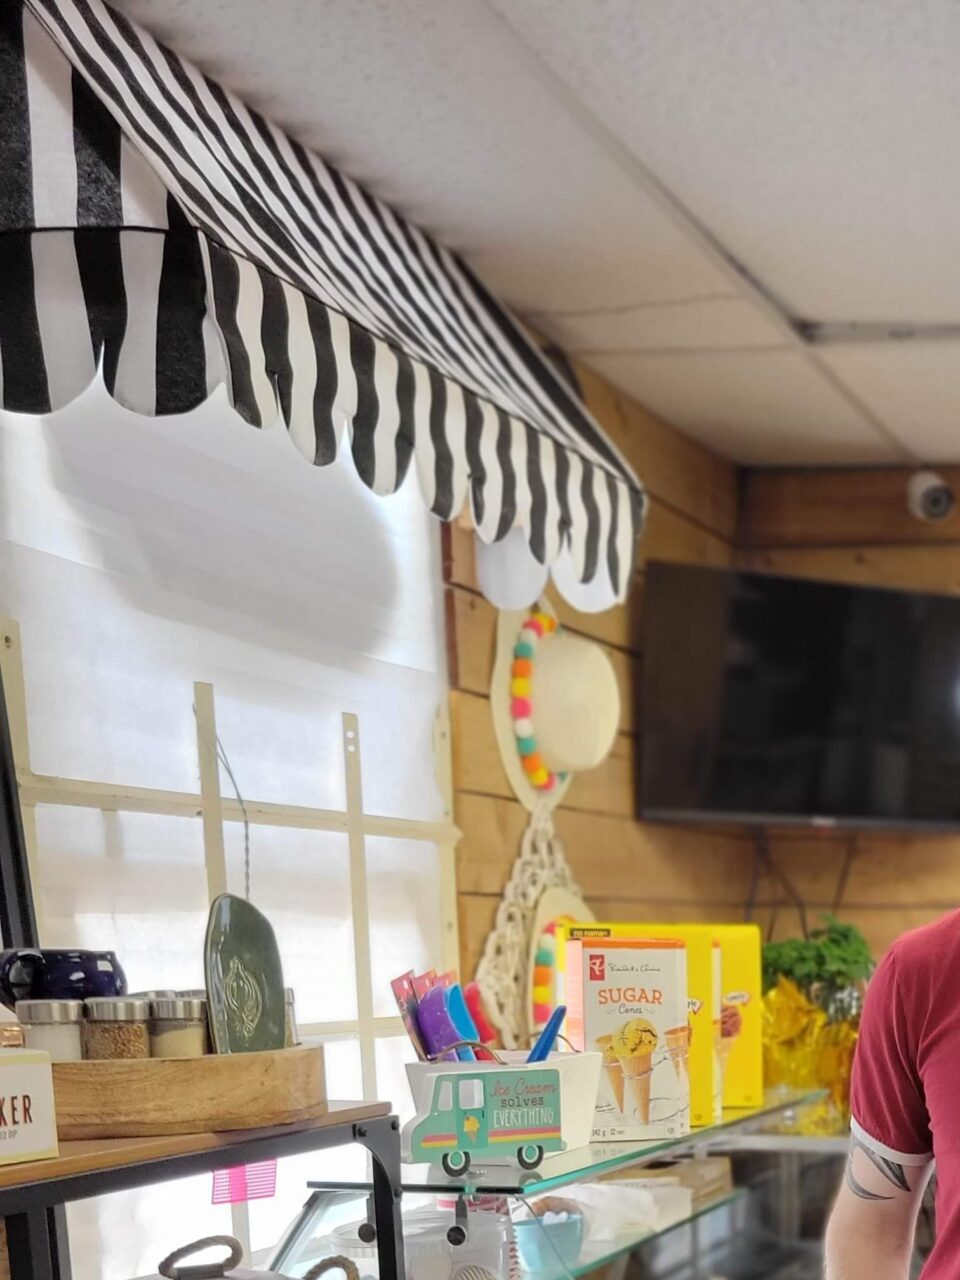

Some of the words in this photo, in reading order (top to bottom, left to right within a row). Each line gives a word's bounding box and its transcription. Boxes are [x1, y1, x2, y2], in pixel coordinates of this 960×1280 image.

[598, 987, 663, 1006] SUGAR
[618, 1003, 643, 1015] Cones
[514, 1077, 559, 1096] Cream
[501, 1096, 544, 1108] solves
[493, 1108, 554, 1128] EVERYTHING
